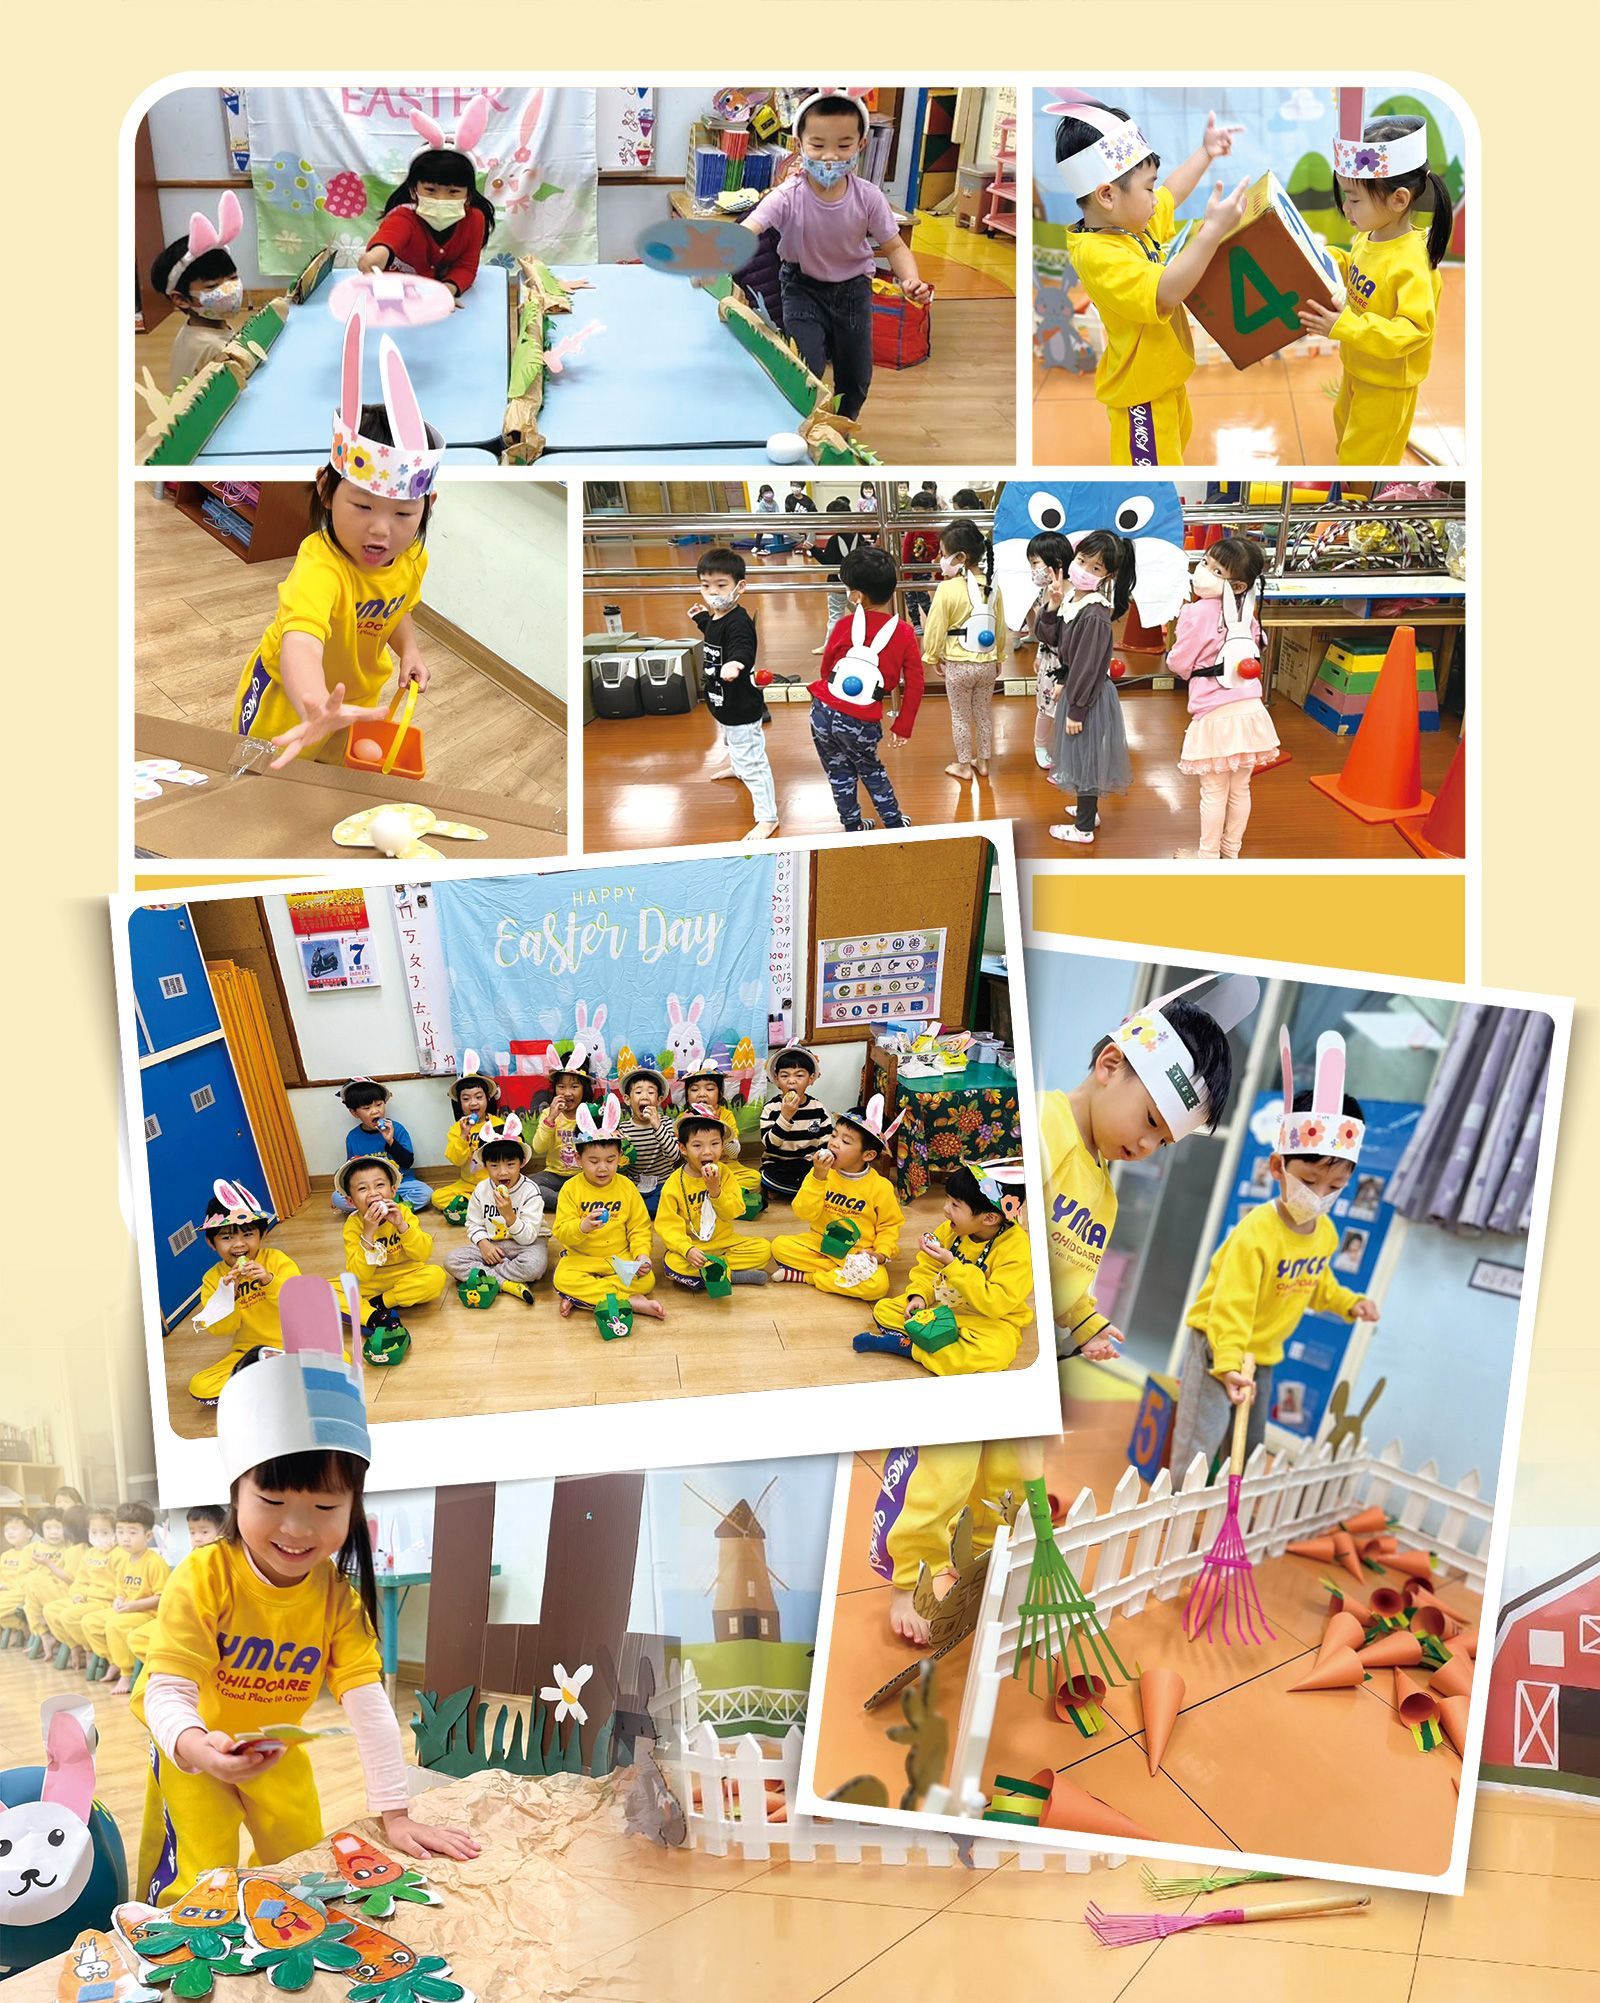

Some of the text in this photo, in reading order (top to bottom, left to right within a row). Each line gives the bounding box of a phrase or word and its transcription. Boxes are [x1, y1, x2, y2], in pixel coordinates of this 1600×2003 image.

[1228, 246, 1301, 335] 4
[572, 886, 637, 907] HAPPY
[494, 906, 725, 976] Easter Day
[349, 943, 365, 965] 7
[824, 1190, 866, 1212] YMCA
[1136, 1390, 1164, 1466] 5
[216, 1632, 322, 1676] YMCA
[217, 1670, 312, 1693] CHILDCARE
[221, 1687, 247, 1701] Good
[248, 1692, 274, 1704] Place
[275, 1695, 283, 1703] to
